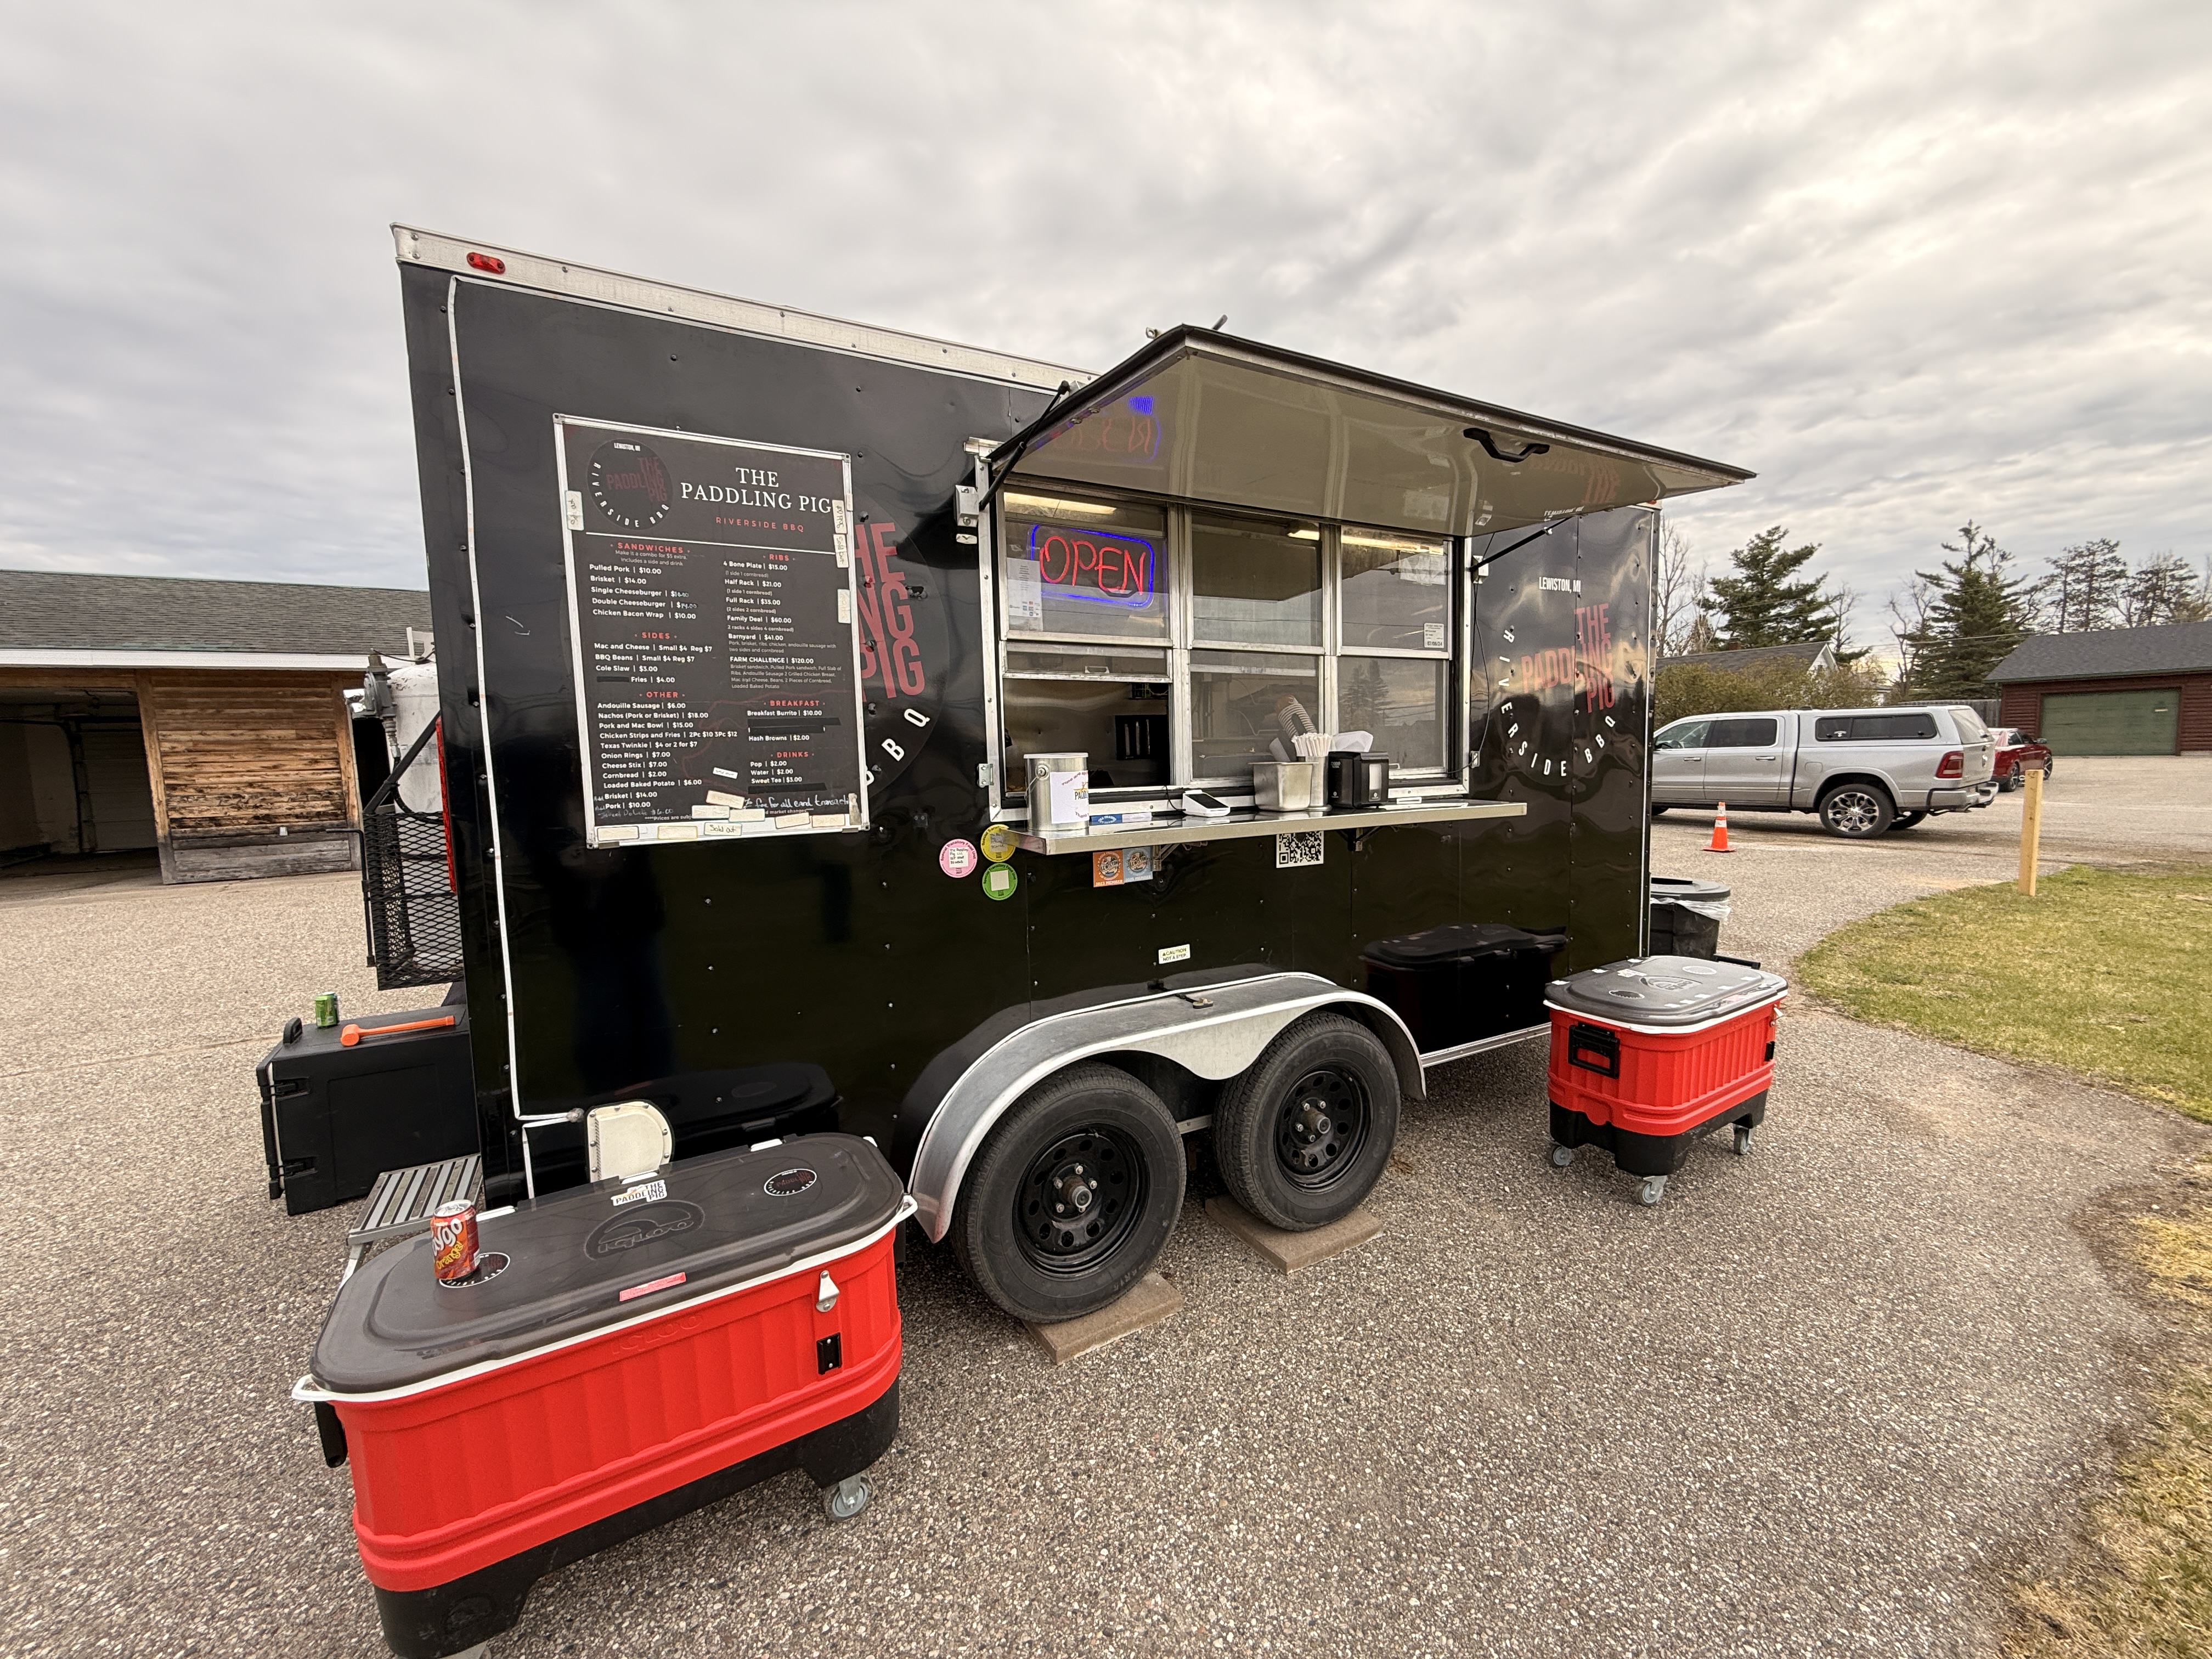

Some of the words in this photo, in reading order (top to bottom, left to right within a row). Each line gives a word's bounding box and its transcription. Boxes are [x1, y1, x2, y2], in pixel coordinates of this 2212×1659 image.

[735, 467, 778, 487] THE
[680, 482, 792, 509] PADDLING
[799, 495, 831, 514] PIG
[716, 517, 776, 529] RIVERSIDE
[783, 523, 803, 532] BBQ
[618, 542, 683, 553] SANDWICHES
[1040, 535, 1147, 595] OPEN
[614, 588, 662, 597] Cheeseburger
[1539, 577, 1572, 594] LEWISTON,
[1572, 580, 1581, 592] MI
[619, 599, 665, 608] Cheeseburger
[1574, 603, 1611, 644] THE
[1521, 638, 1613, 694] PADDLING
[1498, 629, 1567, 777] RIVERSIDE
[1584, 715, 1616, 764] BBQ
[1586, 676, 1615, 713] PIG
[781, 798, 793, 808] all
[794, 798, 813, 808] card
[646, 1181, 662, 1190] THE
[616, 1186, 664, 1204] PADDLING
[649, 1192, 664, 1200] PIG
[432, 1218, 462, 1256] aygo
